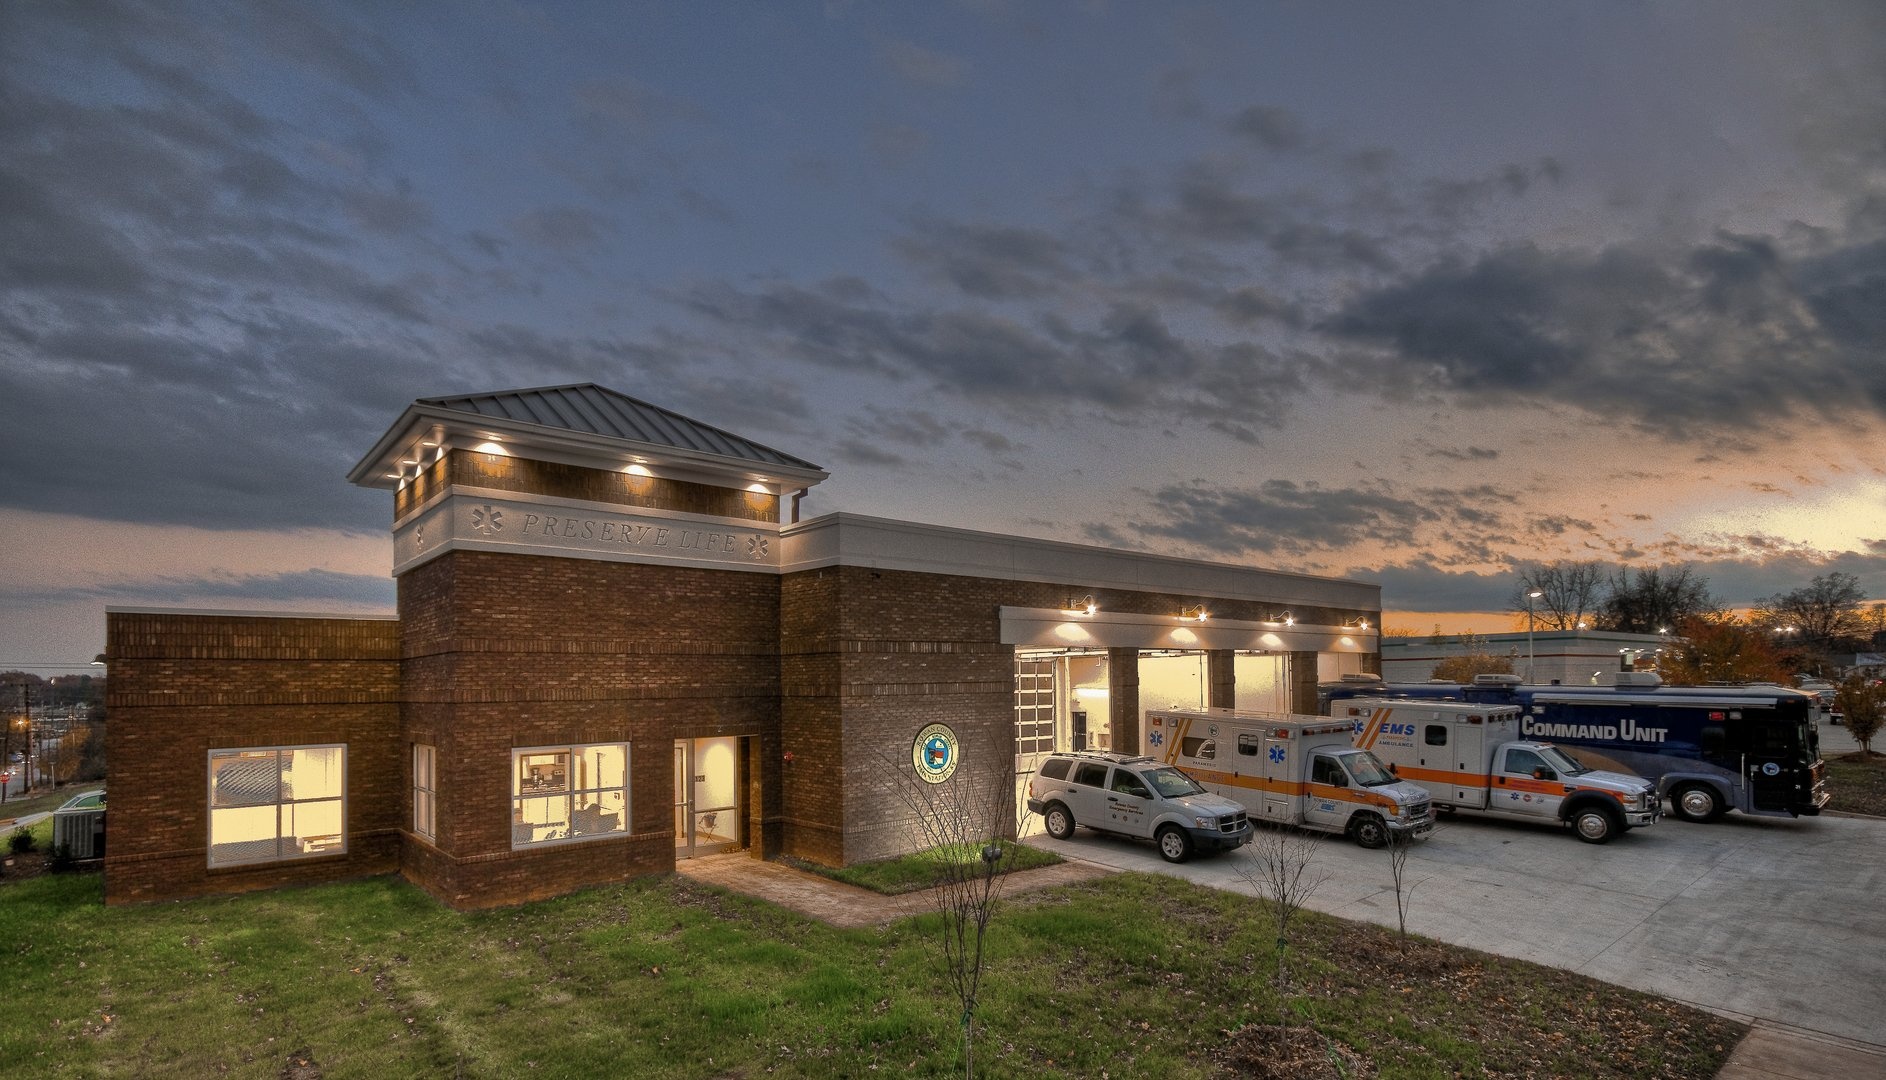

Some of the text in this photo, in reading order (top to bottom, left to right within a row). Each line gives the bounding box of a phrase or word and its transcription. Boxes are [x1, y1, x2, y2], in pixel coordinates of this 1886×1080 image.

[522, 514, 736, 553] PRESERVE LIFE
[936, 726, 957, 746] COUNTY
[1379, 722, 1416, 736] EMS
[1522, 715, 1669, 743] COMMAND UNIT
[1378, 740, 1414, 748] AMBULANCE
[1192, 760, 1217, 768] PARAMEDIC
